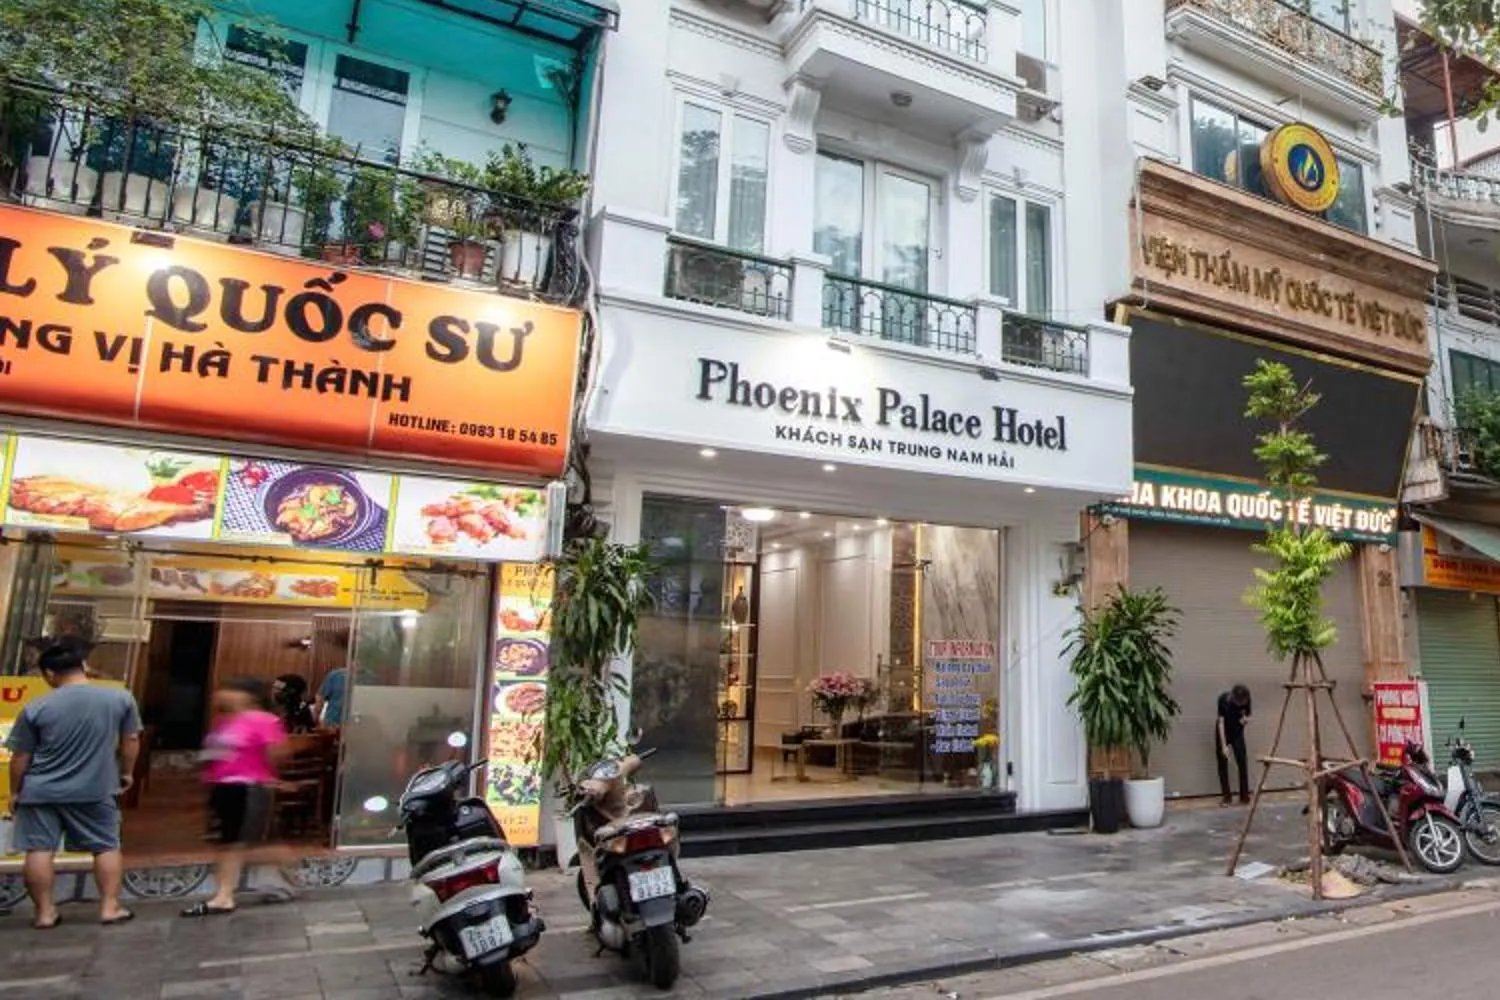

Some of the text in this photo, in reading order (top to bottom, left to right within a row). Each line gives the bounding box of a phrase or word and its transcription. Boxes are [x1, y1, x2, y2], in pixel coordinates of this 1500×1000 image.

[0, 236, 535, 373] LÝ QUỐC SƯ
[94, 331, 143, 374] VỊ
[160, 341, 232, 378] HÀ
[251, 354, 412, 403] THÀNH
[388, 412, 456, 435] HOTLINE:
[696, 357, 1068, 451] Phoenix Palace Hotel
[775, 424, 1015, 469] KHÁCH SẠN TRUNG NAM HẢI
[1161, 484, 1222, 515] KHOA
[1226, 490, 1283, 521] QUỐC
[1314, 503, 1353, 532] VIỆT
[1354, 507, 1393, 534] ĐỨC
